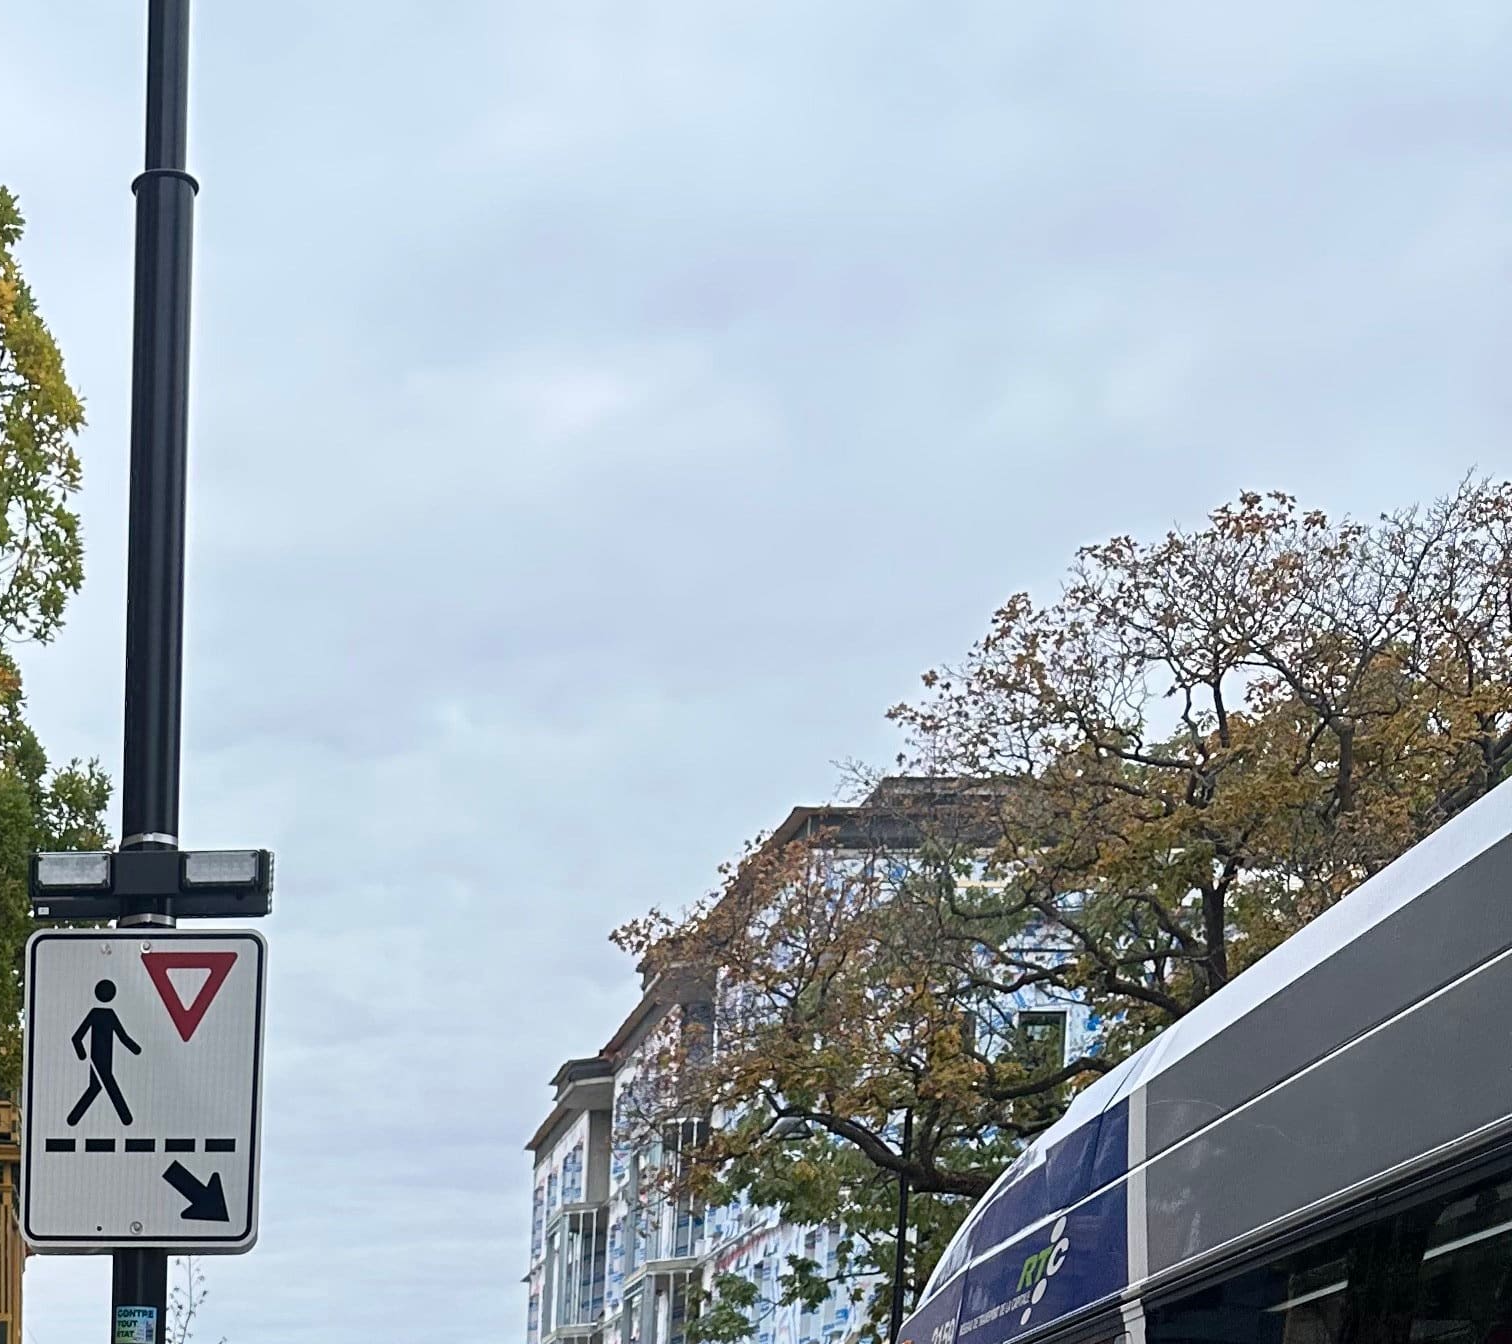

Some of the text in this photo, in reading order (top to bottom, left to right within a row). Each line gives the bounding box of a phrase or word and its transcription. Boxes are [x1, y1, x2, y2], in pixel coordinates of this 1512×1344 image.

[1016, 1238, 1070, 1292] RTC
[117, 1309, 154, 1319] CONTRE
[117, 1320, 138, 1328] TOUT
